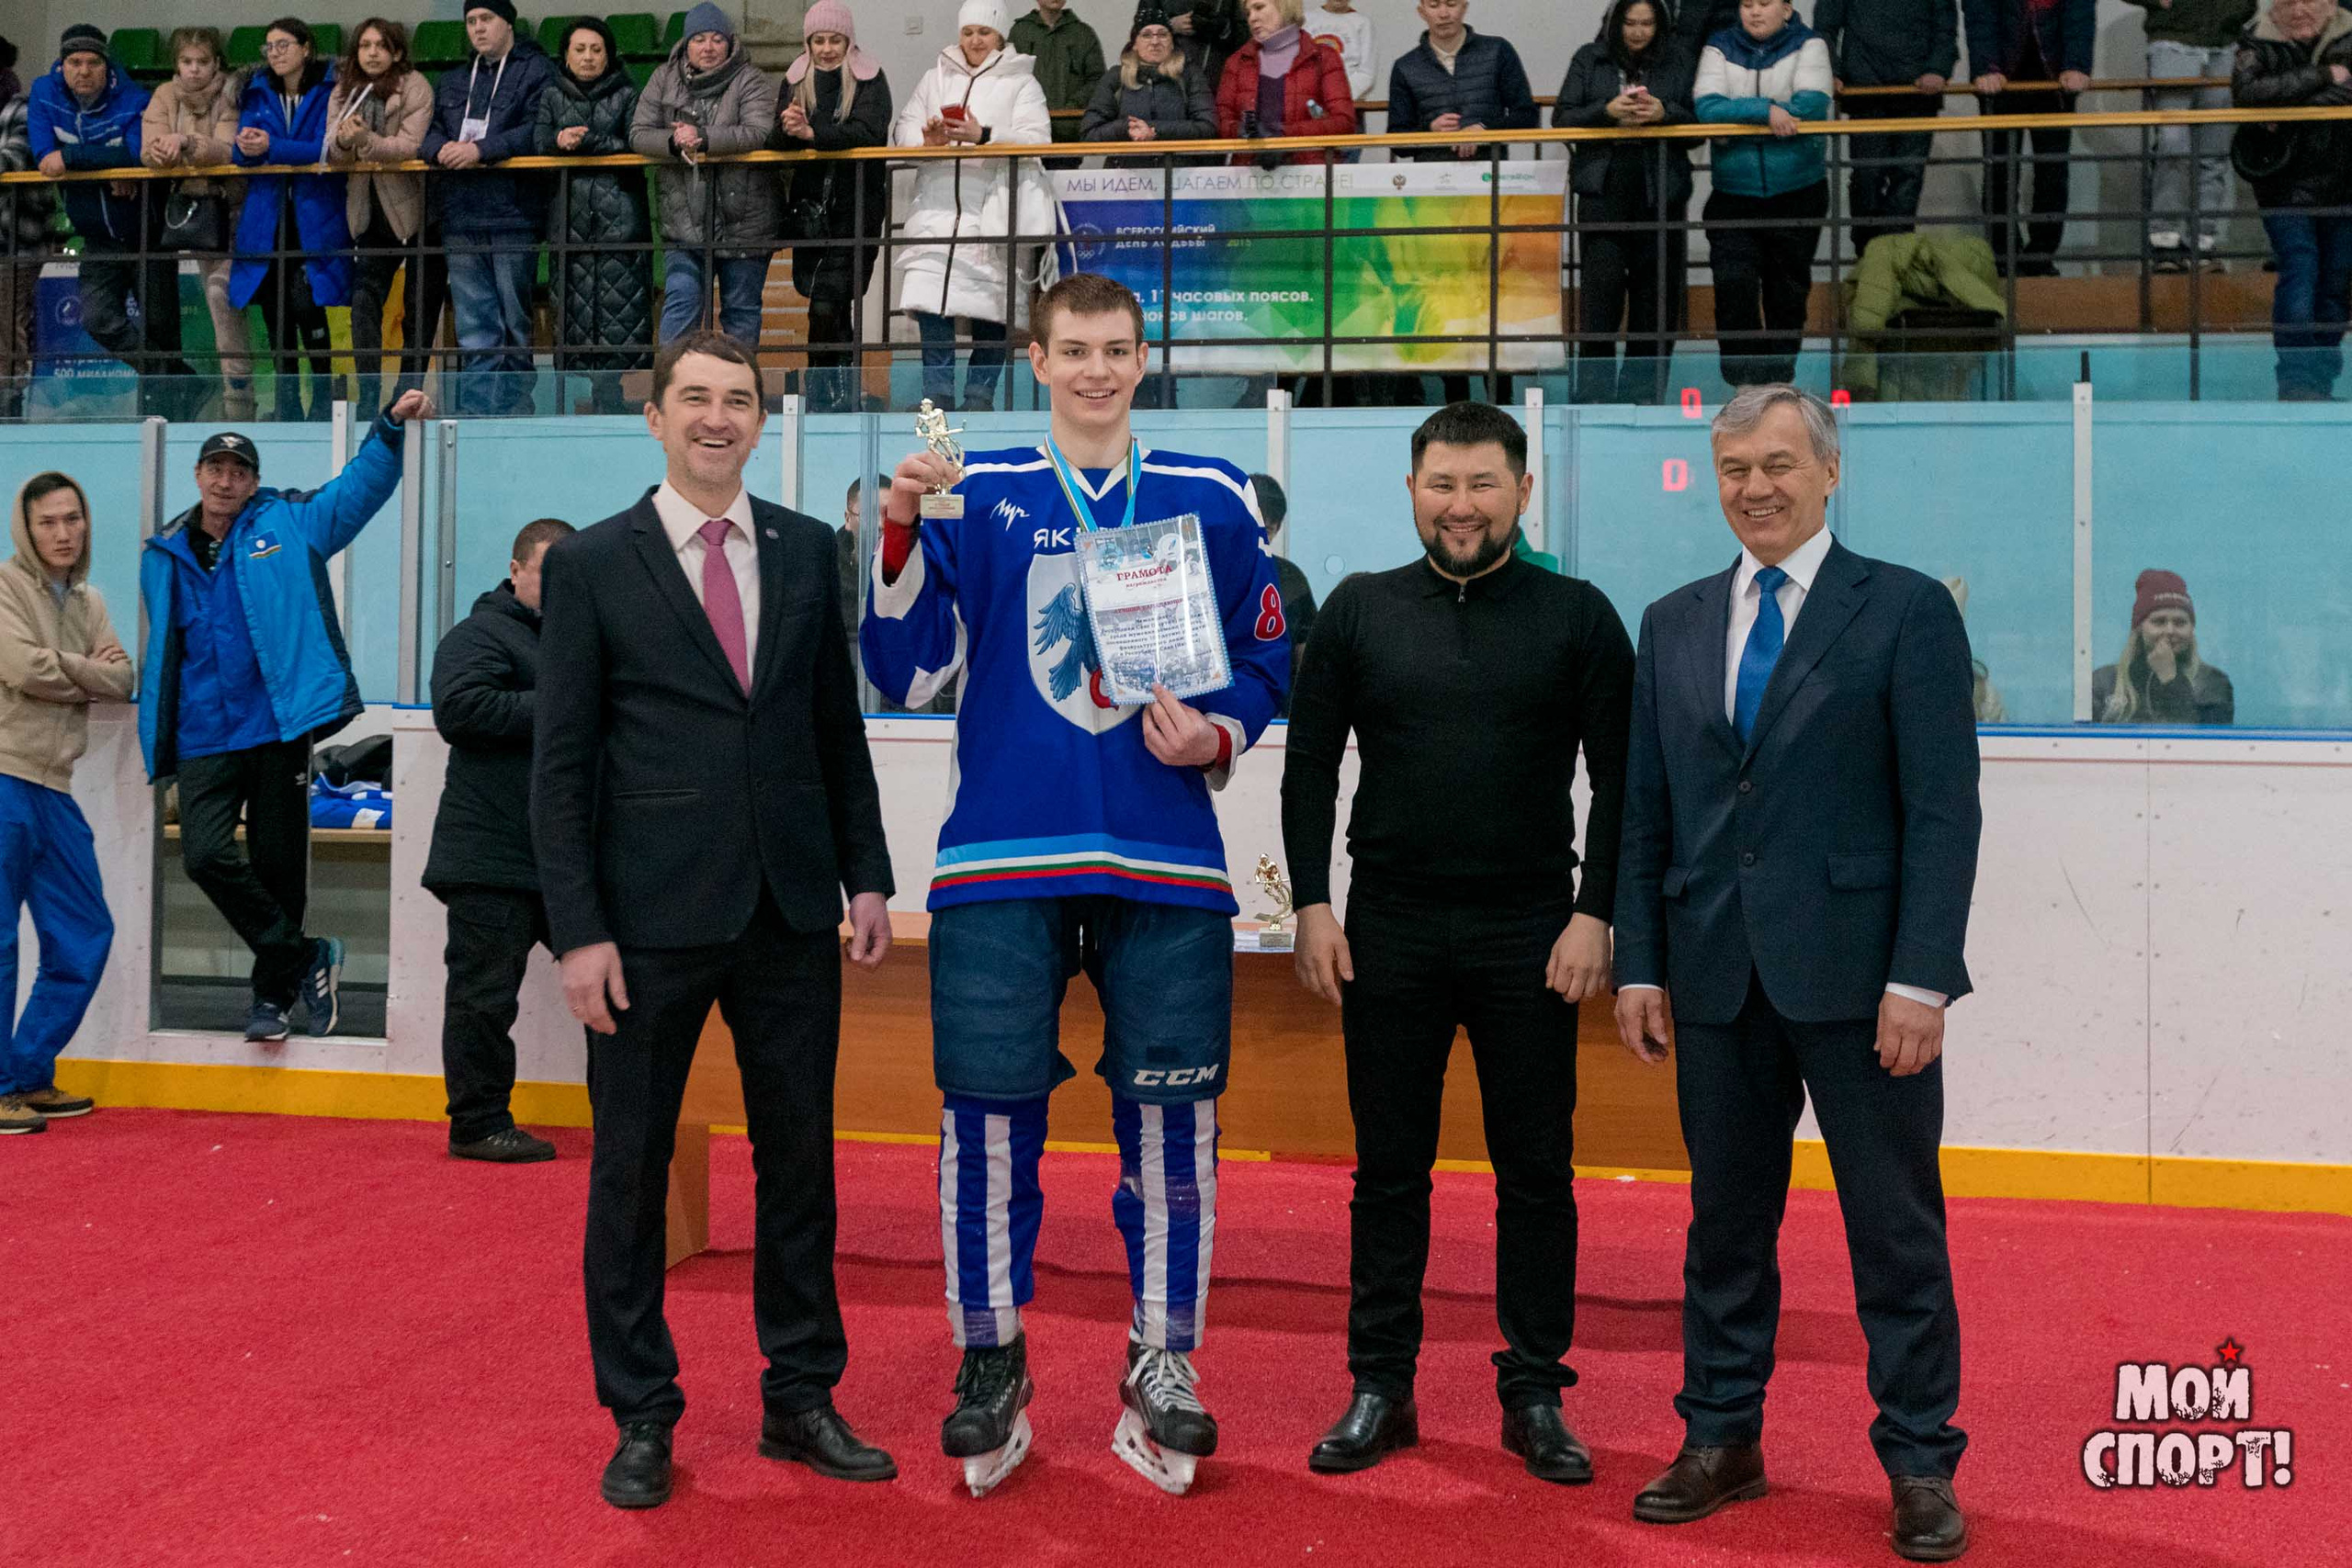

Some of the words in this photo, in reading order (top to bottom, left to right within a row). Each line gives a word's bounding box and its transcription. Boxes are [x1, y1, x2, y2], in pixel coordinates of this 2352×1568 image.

[1067, 178, 1096, 192] МЫ
[1102, 176, 1158, 193] ИДЕМ,
[1248, 174, 1274, 190] ПО
[1172, 290, 1245, 303] часовых
[1249, 290, 1314, 303] поясов.
[1192, 310, 1249, 321] шагов.
[1116, 564, 1173, 581] ГРАМОТА
[1133, 1063, 1220, 1086] CCM
